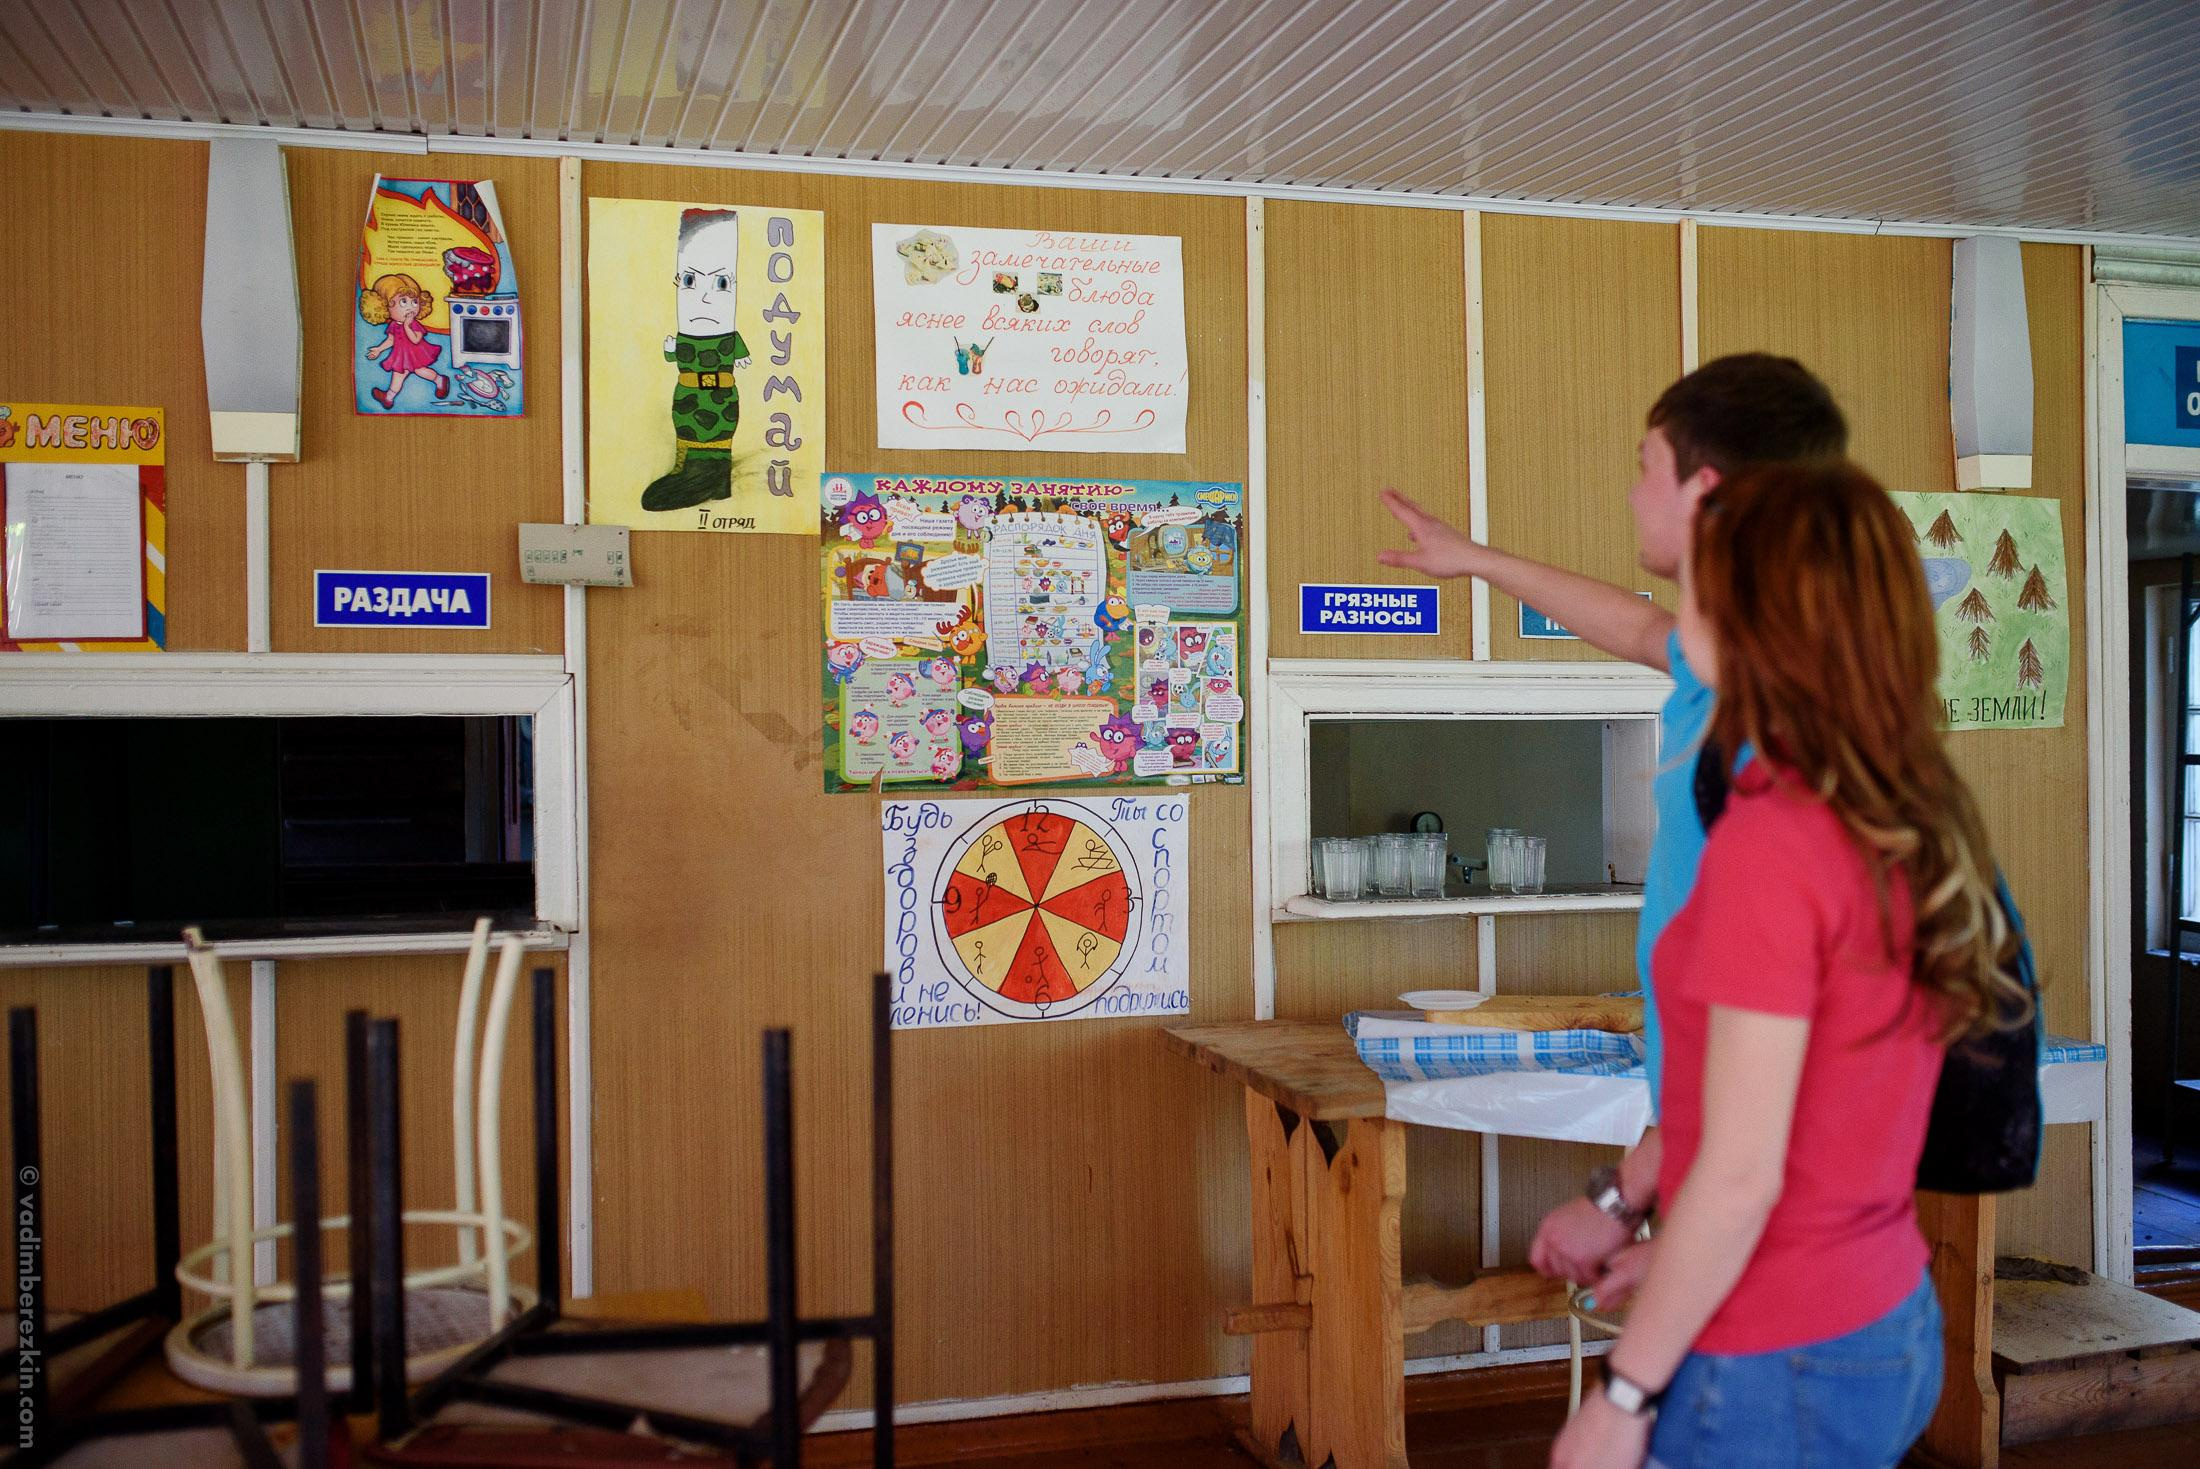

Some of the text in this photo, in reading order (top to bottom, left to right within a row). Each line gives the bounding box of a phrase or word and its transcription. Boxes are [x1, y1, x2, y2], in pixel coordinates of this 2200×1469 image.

[1024, 231, 1138, 252] Ваши
[956, 250, 1161, 286] замечательные
[1067, 276, 1157, 306] блюда
[895, 303, 1146, 335] яснее всяких слов
[897, 373, 951, 393] как
[983, 376, 1039, 395] нас
[25, 413, 161, 451] МЕНЮ
[875, 479, 1003, 495] КАЖДОМУ
[1071, 502, 1106, 512] свое
[992, 523, 1097, 539] РАСПОРЯДОК ДНЯ
[333, 586, 472, 617] РАЗДАЧА
[1323, 591, 1418, 608] ГРЯЗНЫЕ
[1319, 609, 1422, 626] РАЗНОСЫ
[1967, 690, 2047, 722] ЗЕМЛИ!
[882, 803, 953, 836] Будь
[1019, 805, 1050, 834] 12
[1109, 797, 1147, 822] Ты
[943, 885, 962, 914] 9
[1123, 886, 1135, 914] 3
[918, 981, 950, 1003] не
[1034, 984, 1052, 1012] 6
